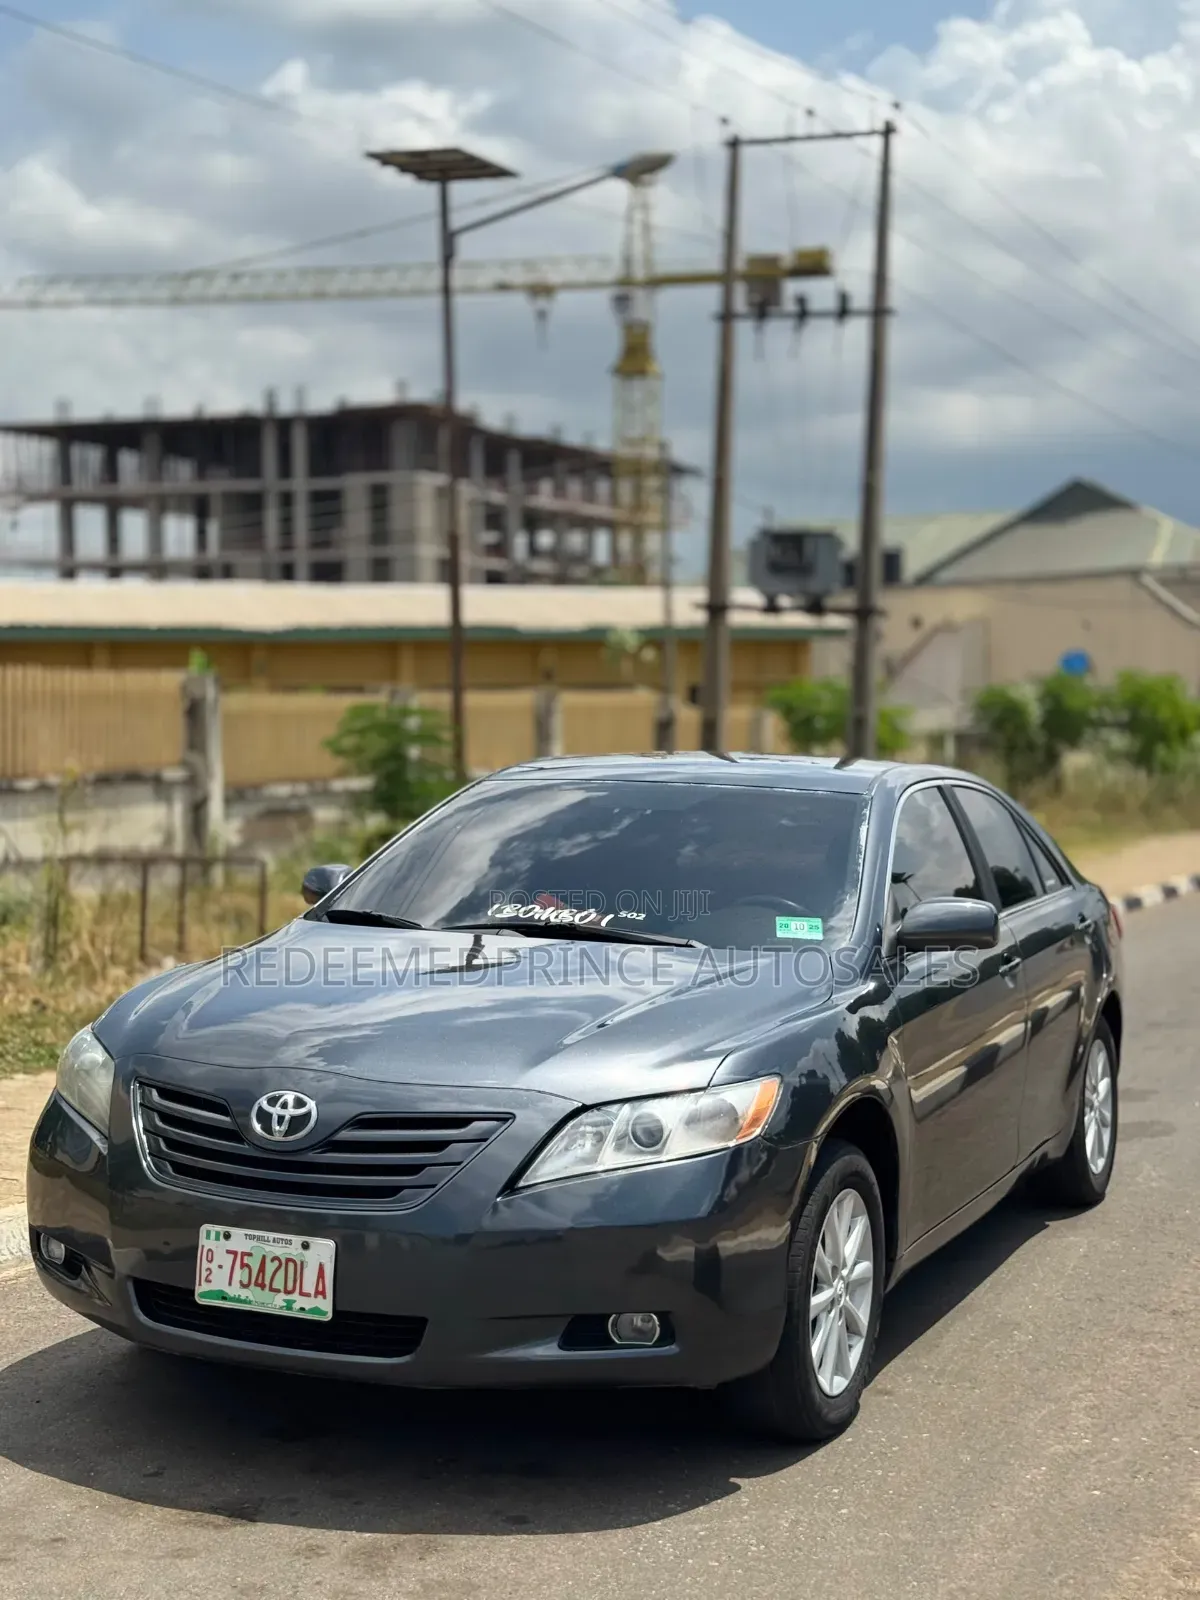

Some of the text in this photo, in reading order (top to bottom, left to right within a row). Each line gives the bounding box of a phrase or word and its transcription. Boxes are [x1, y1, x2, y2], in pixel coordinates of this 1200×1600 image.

[793, 922, 805, 931] 10
[243, 1233, 293, 1246] TOPHILL AUTOS
